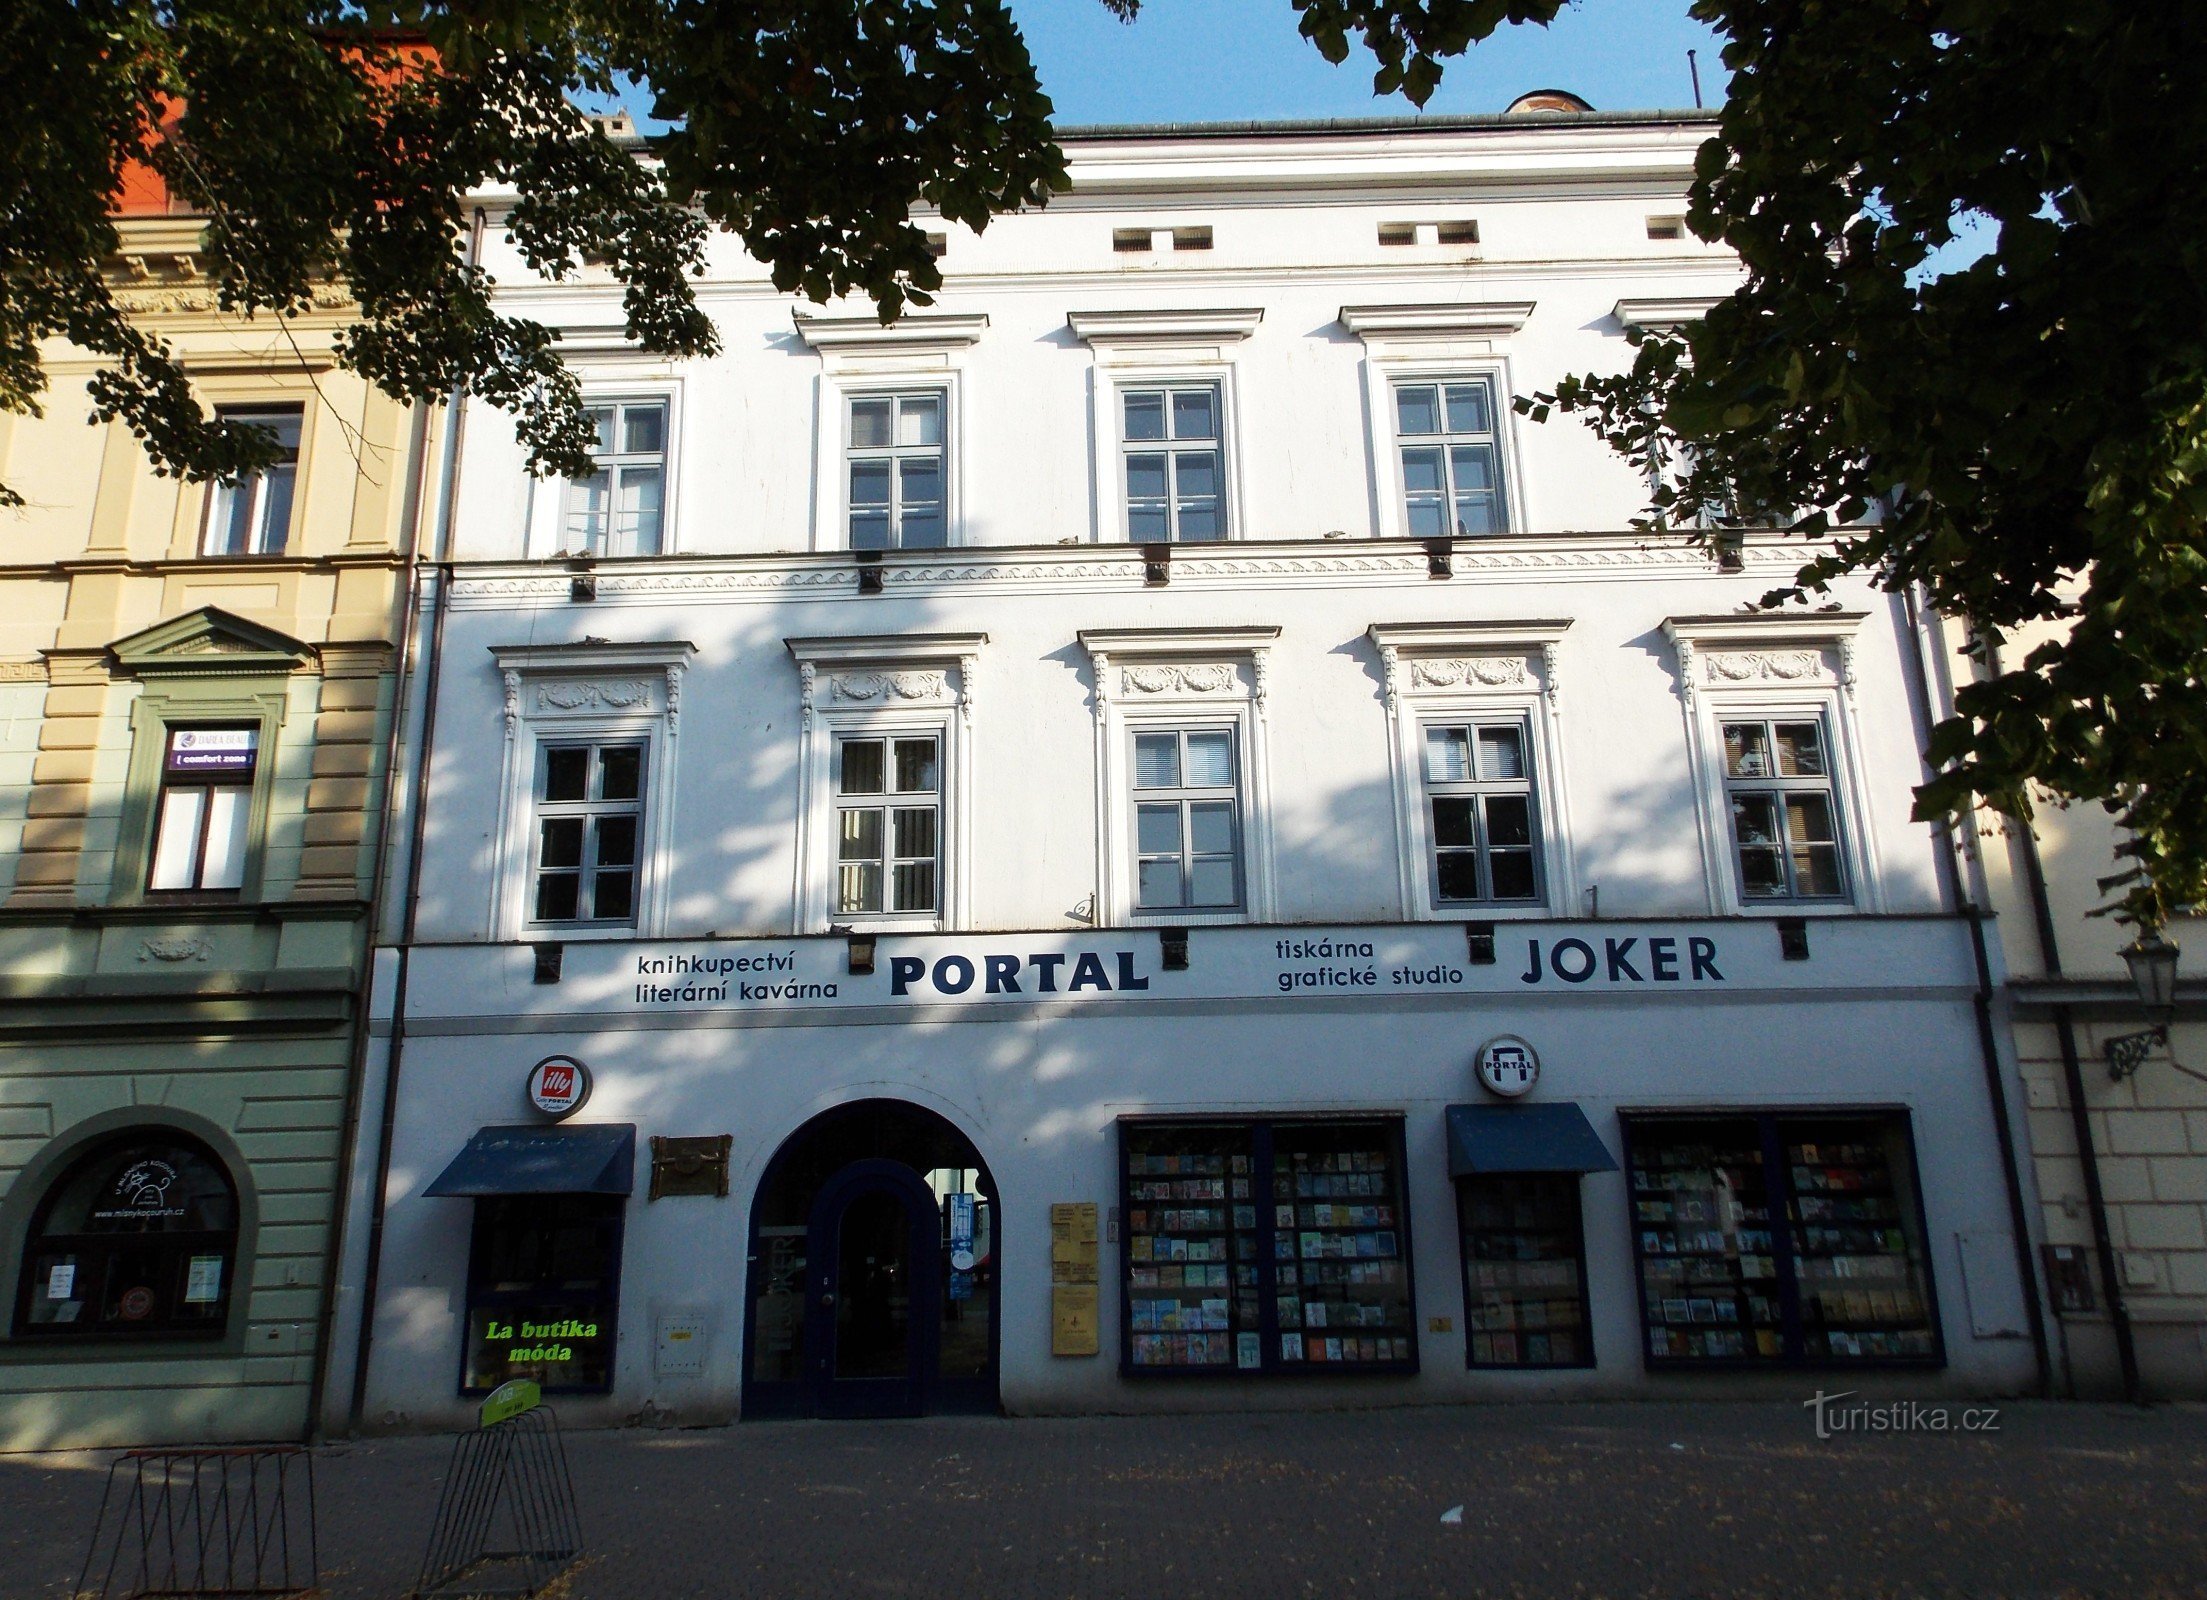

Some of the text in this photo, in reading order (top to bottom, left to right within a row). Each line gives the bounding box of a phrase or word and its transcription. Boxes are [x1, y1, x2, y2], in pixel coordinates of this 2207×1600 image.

[183, 755, 222, 764] comfort
[1276, 937, 1373, 959] tiskárna
[1520, 936, 1726, 984] JOKER
[637, 950, 796, 976] knihkupectví
[889, 951, 1149, 996] PORTAL
[1278, 963, 1464, 992] grafické studio
[635, 977, 838, 1003] literární kavárna
[1485, 1061, 1533, 1069] PORTAL
[543, 1071, 572, 1095] illy
[485, 1320, 597, 1339] La butika
[508, 1343, 572, 1362] móda
